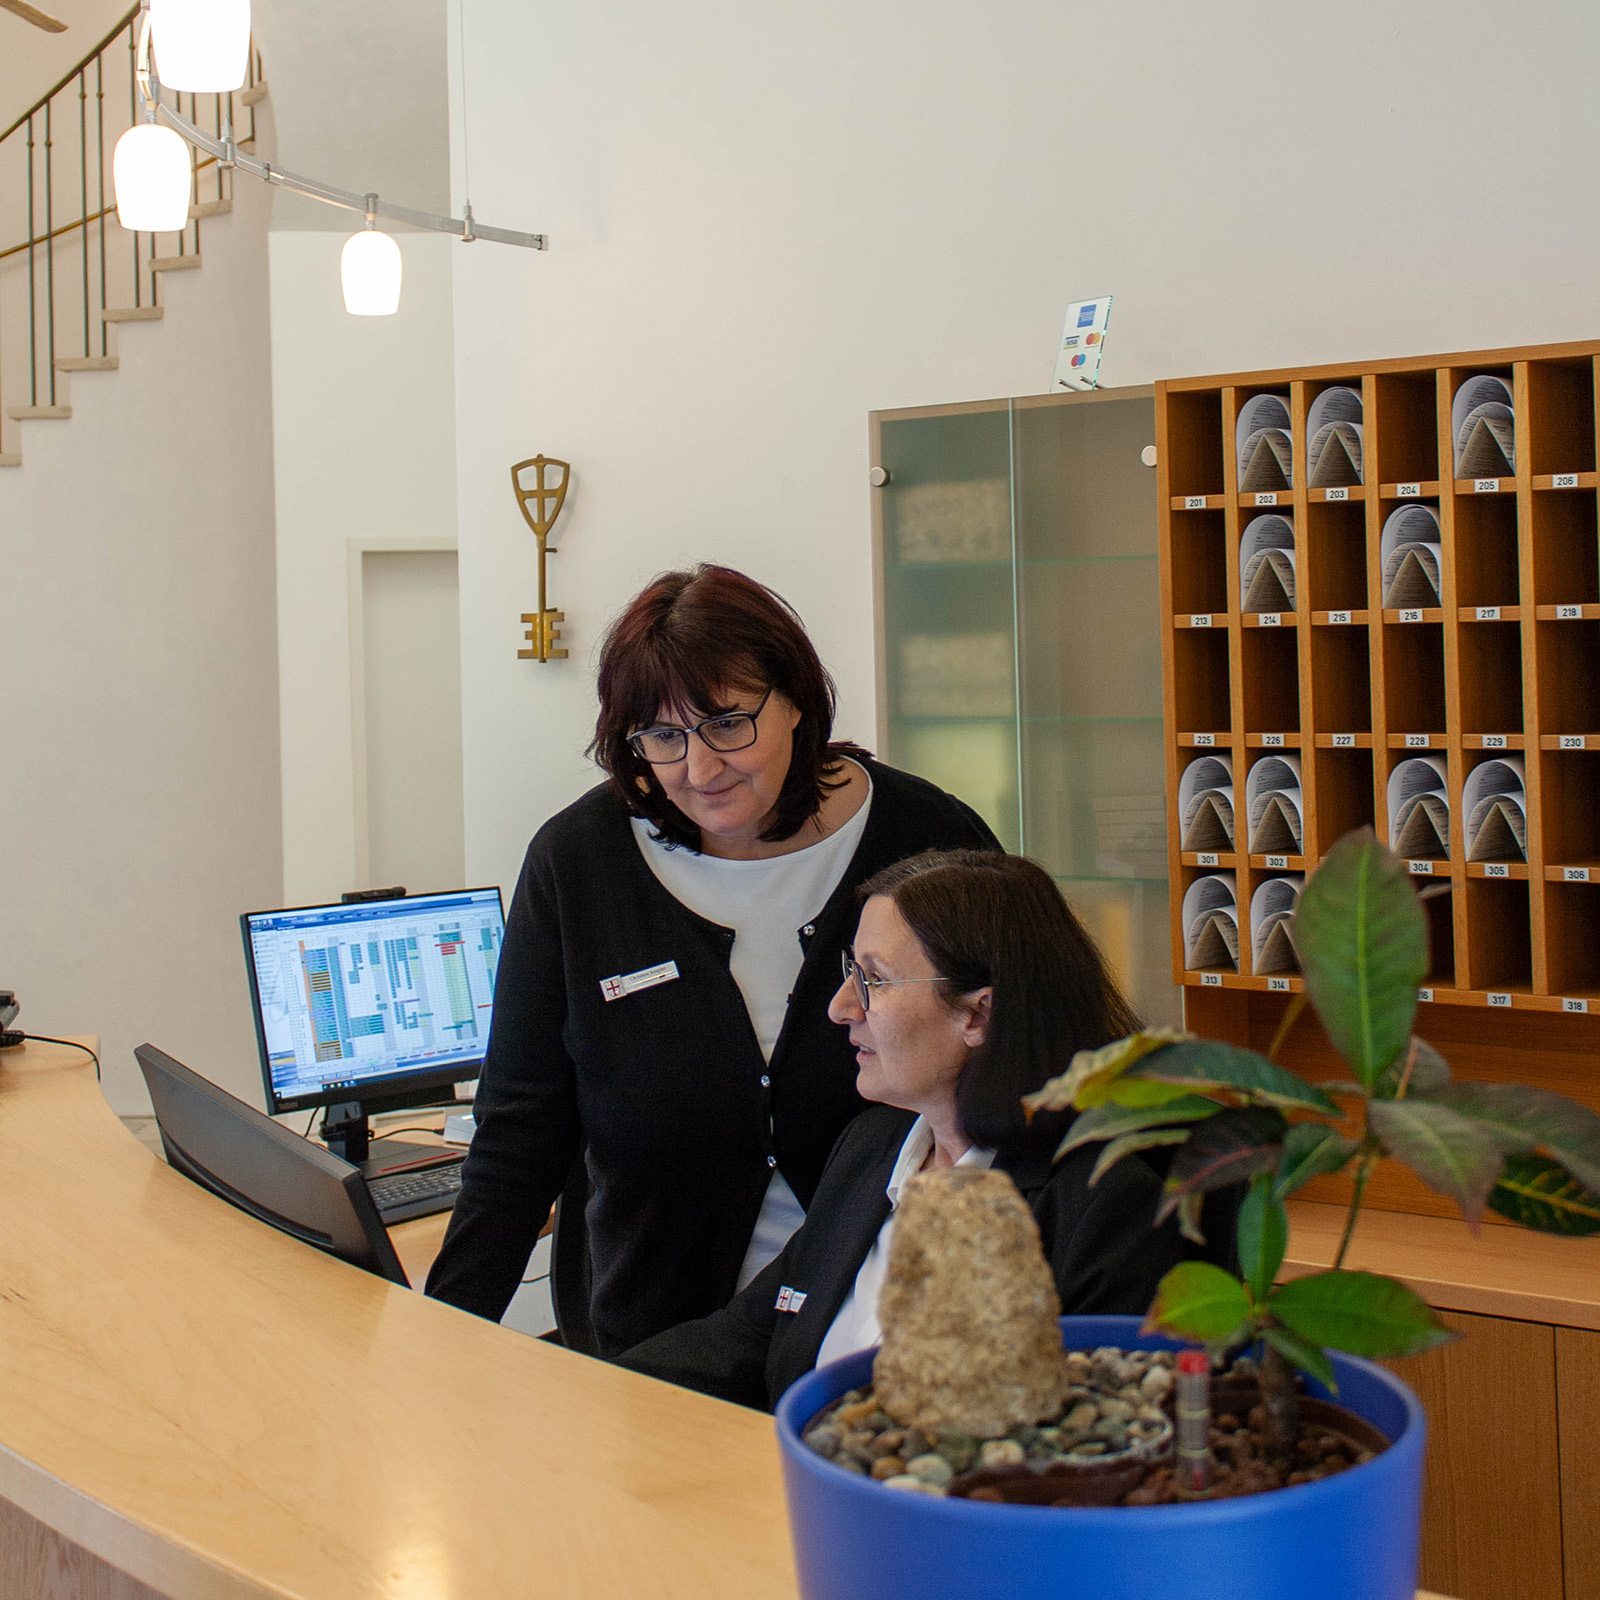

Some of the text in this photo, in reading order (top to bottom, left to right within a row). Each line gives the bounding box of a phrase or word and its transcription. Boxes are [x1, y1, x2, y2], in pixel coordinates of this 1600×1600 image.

[1478, 480, 1495, 491] 205
[1557, 476, 1574, 486] 206
[1329, 489, 1345, 499] 203
[1400, 485, 1416, 495] 204
[1189, 498, 1202, 508] 201
[1258, 494, 1274, 504] 202
[1332, 612, 1347, 623] 215
[1404, 611, 1419, 621] 216
[1481, 609, 1496, 619] 217
[1562, 607, 1578, 618] 218
[1195, 616, 1208, 626] 213
[1263, 615, 1277, 625] 214
[1196, 735, 1212, 745] 225
[1265, 735, 1281, 745] 226
[1335, 735, 1352, 746] 227
[1409, 736, 1426, 746] 228
[1486, 737, 1504, 747] 229
[1564, 737, 1582, 748] 230
[1201, 855, 1215, 865] 301
[1268, 857, 1285, 867] 302
[1412, 862, 1429, 873] 304
[1488, 865, 1506, 876] 305
[1567, 869, 1586, 880] 306
[1204, 975, 1219, 985] 313
[1271, 979, 1286, 990] 314
[1491, 994, 1508, 1006] 317
[1566, 1000, 1583, 1011] 318
